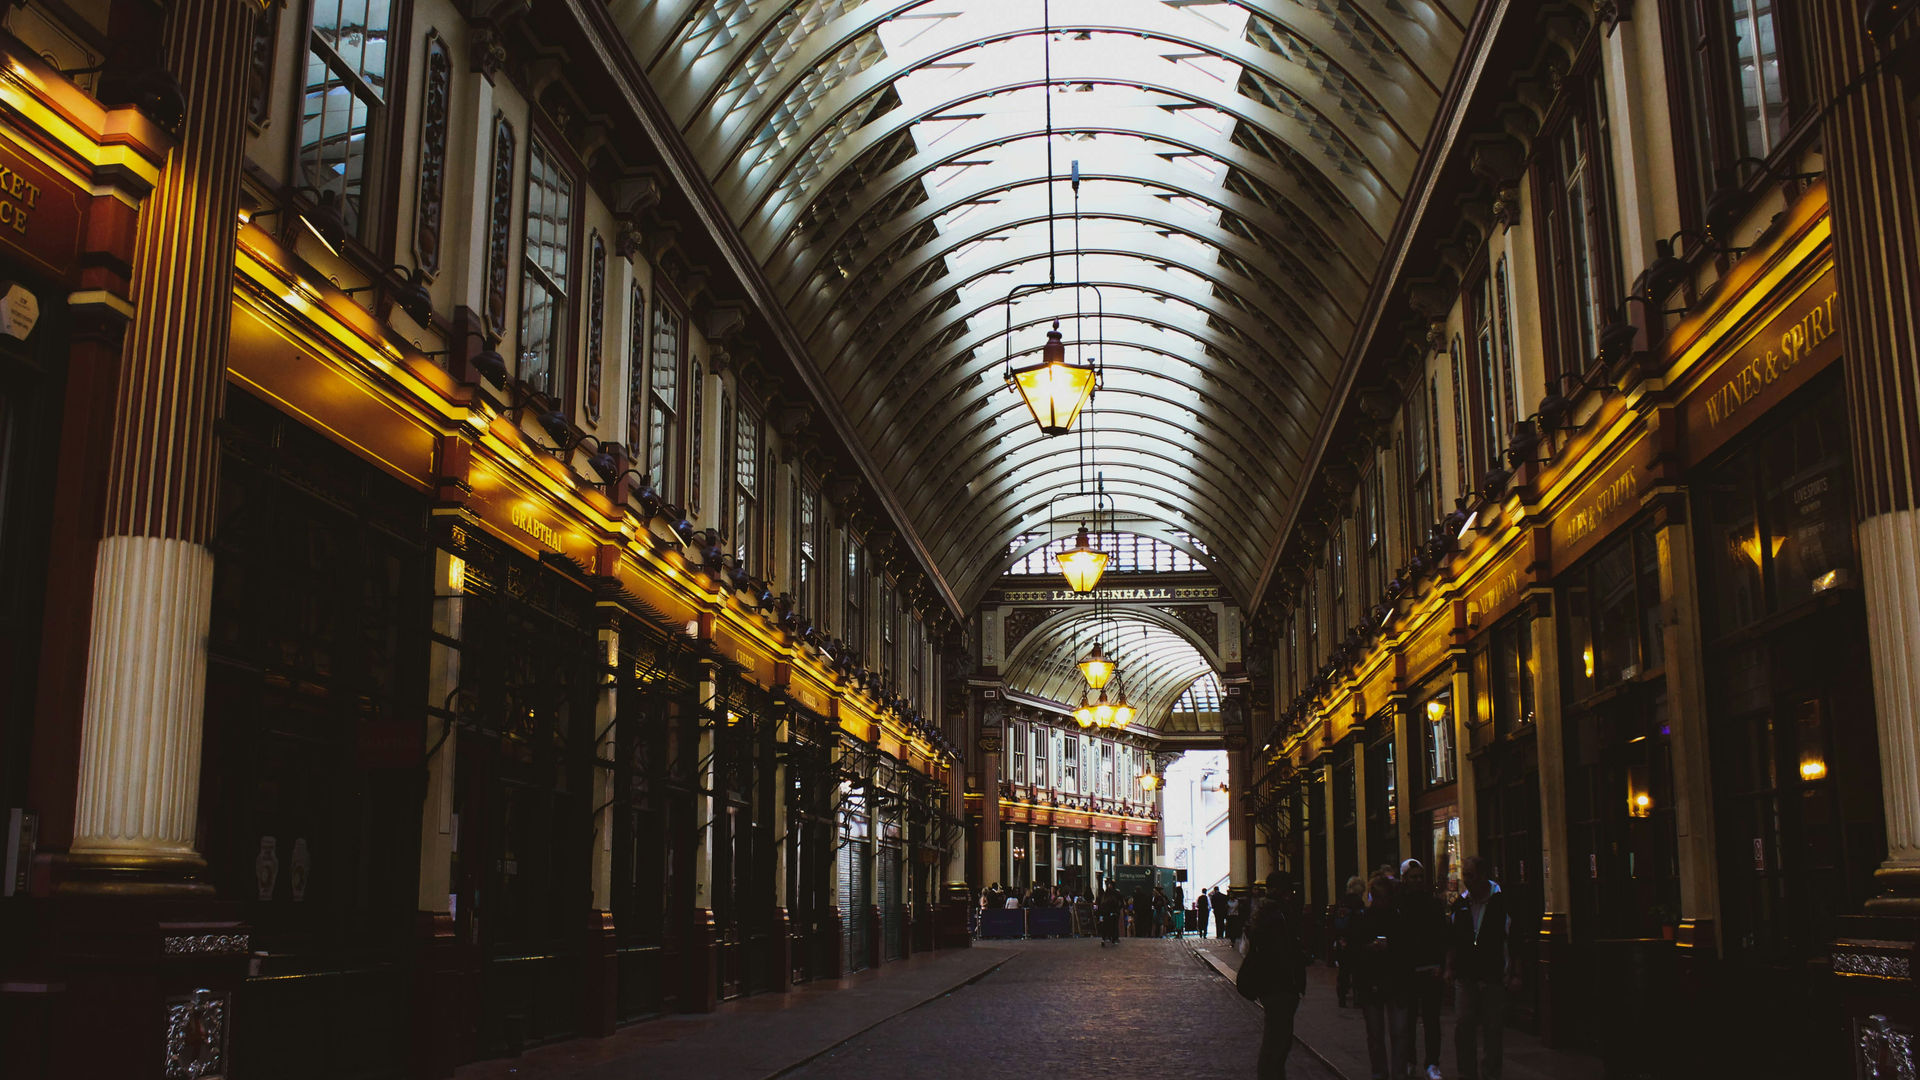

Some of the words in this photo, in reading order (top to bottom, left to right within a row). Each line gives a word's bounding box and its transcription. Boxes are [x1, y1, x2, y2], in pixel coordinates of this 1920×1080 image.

[1705, 357, 1762, 428] WINES
[1765, 350, 1779, 384] &
[1588, 505, 1597, 532] &
[1596, 464, 1637, 522] STOUTS
[590, 555, 597, 575] 2
[1052, 588, 1171, 601] LEADENHALL
